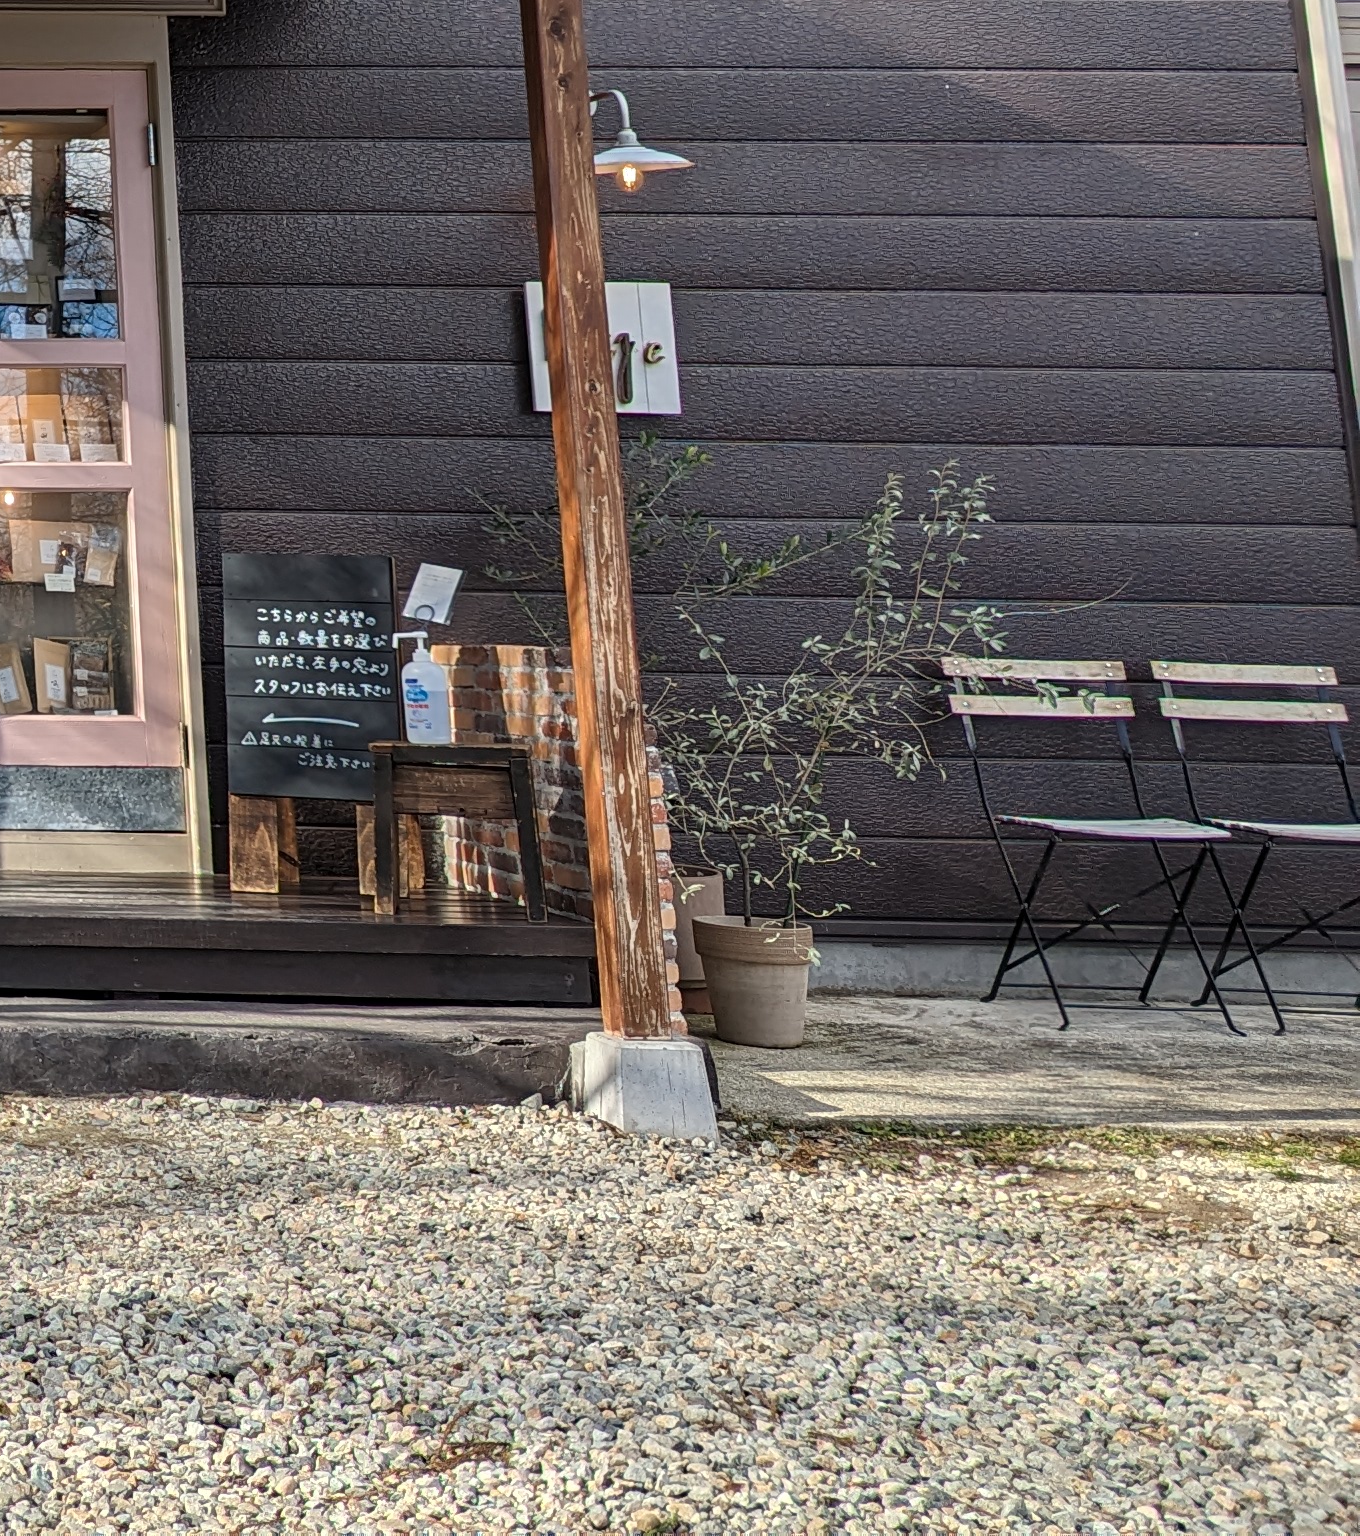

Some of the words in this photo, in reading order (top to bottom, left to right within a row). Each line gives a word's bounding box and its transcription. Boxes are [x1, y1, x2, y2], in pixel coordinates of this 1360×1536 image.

[256, 607, 377, 629] こちらからご希望の
[257, 629, 388, 650] 商品・数量をお選び
[253, 678, 392, 698] スタッフにお伝え下さい
